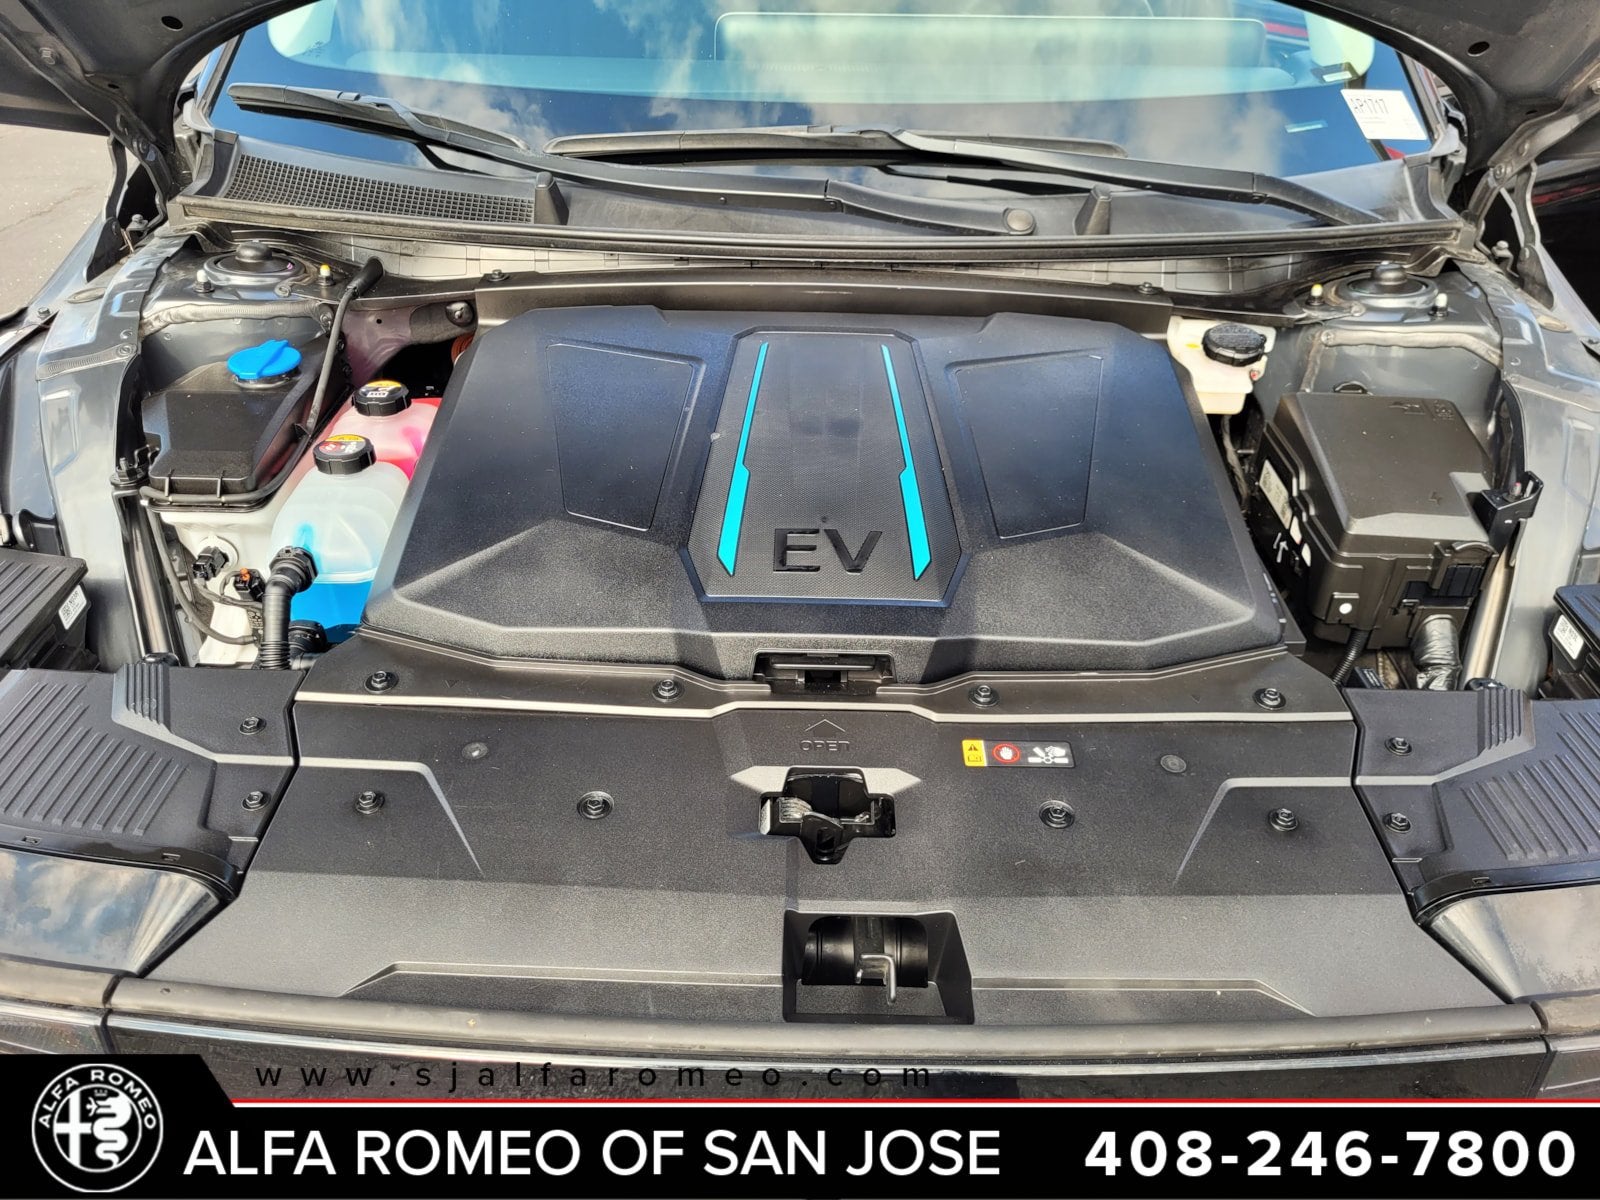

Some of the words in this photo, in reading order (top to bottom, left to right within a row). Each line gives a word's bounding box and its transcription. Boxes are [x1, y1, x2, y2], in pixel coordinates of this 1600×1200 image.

[1350, 97, 1390, 115] AP1717
[773, 528, 883, 573] EV
[800, 740, 850, 752] OPEN
